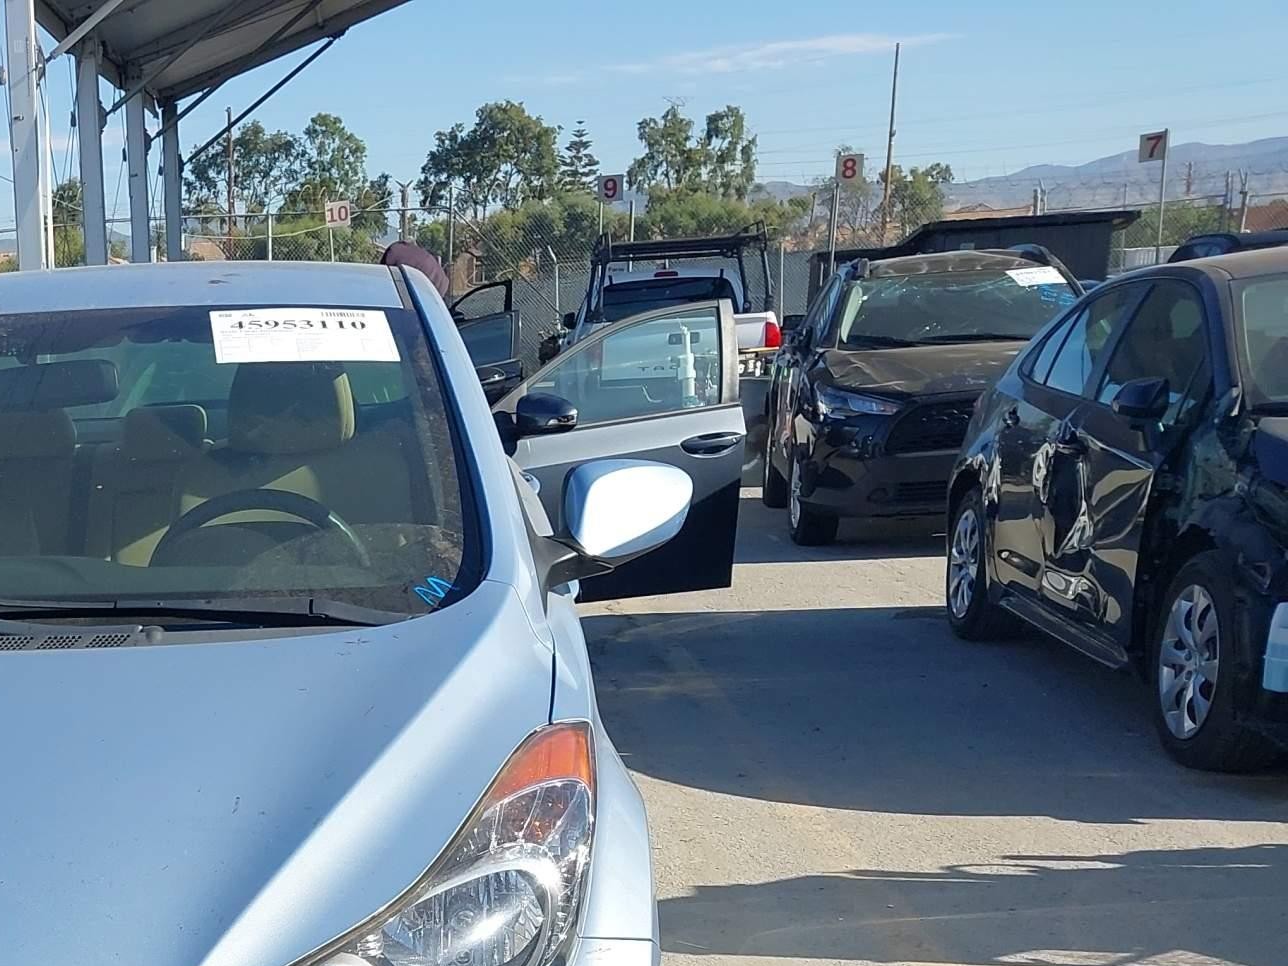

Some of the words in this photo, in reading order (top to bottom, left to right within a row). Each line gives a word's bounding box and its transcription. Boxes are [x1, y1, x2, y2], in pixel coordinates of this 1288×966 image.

[1146, 134, 1163, 158] 7
[842, 158, 857, 179] 8
[603, 178, 618, 198] 9
[327, 205, 348, 223] 10
[230, 319, 366, 330] 45953110
